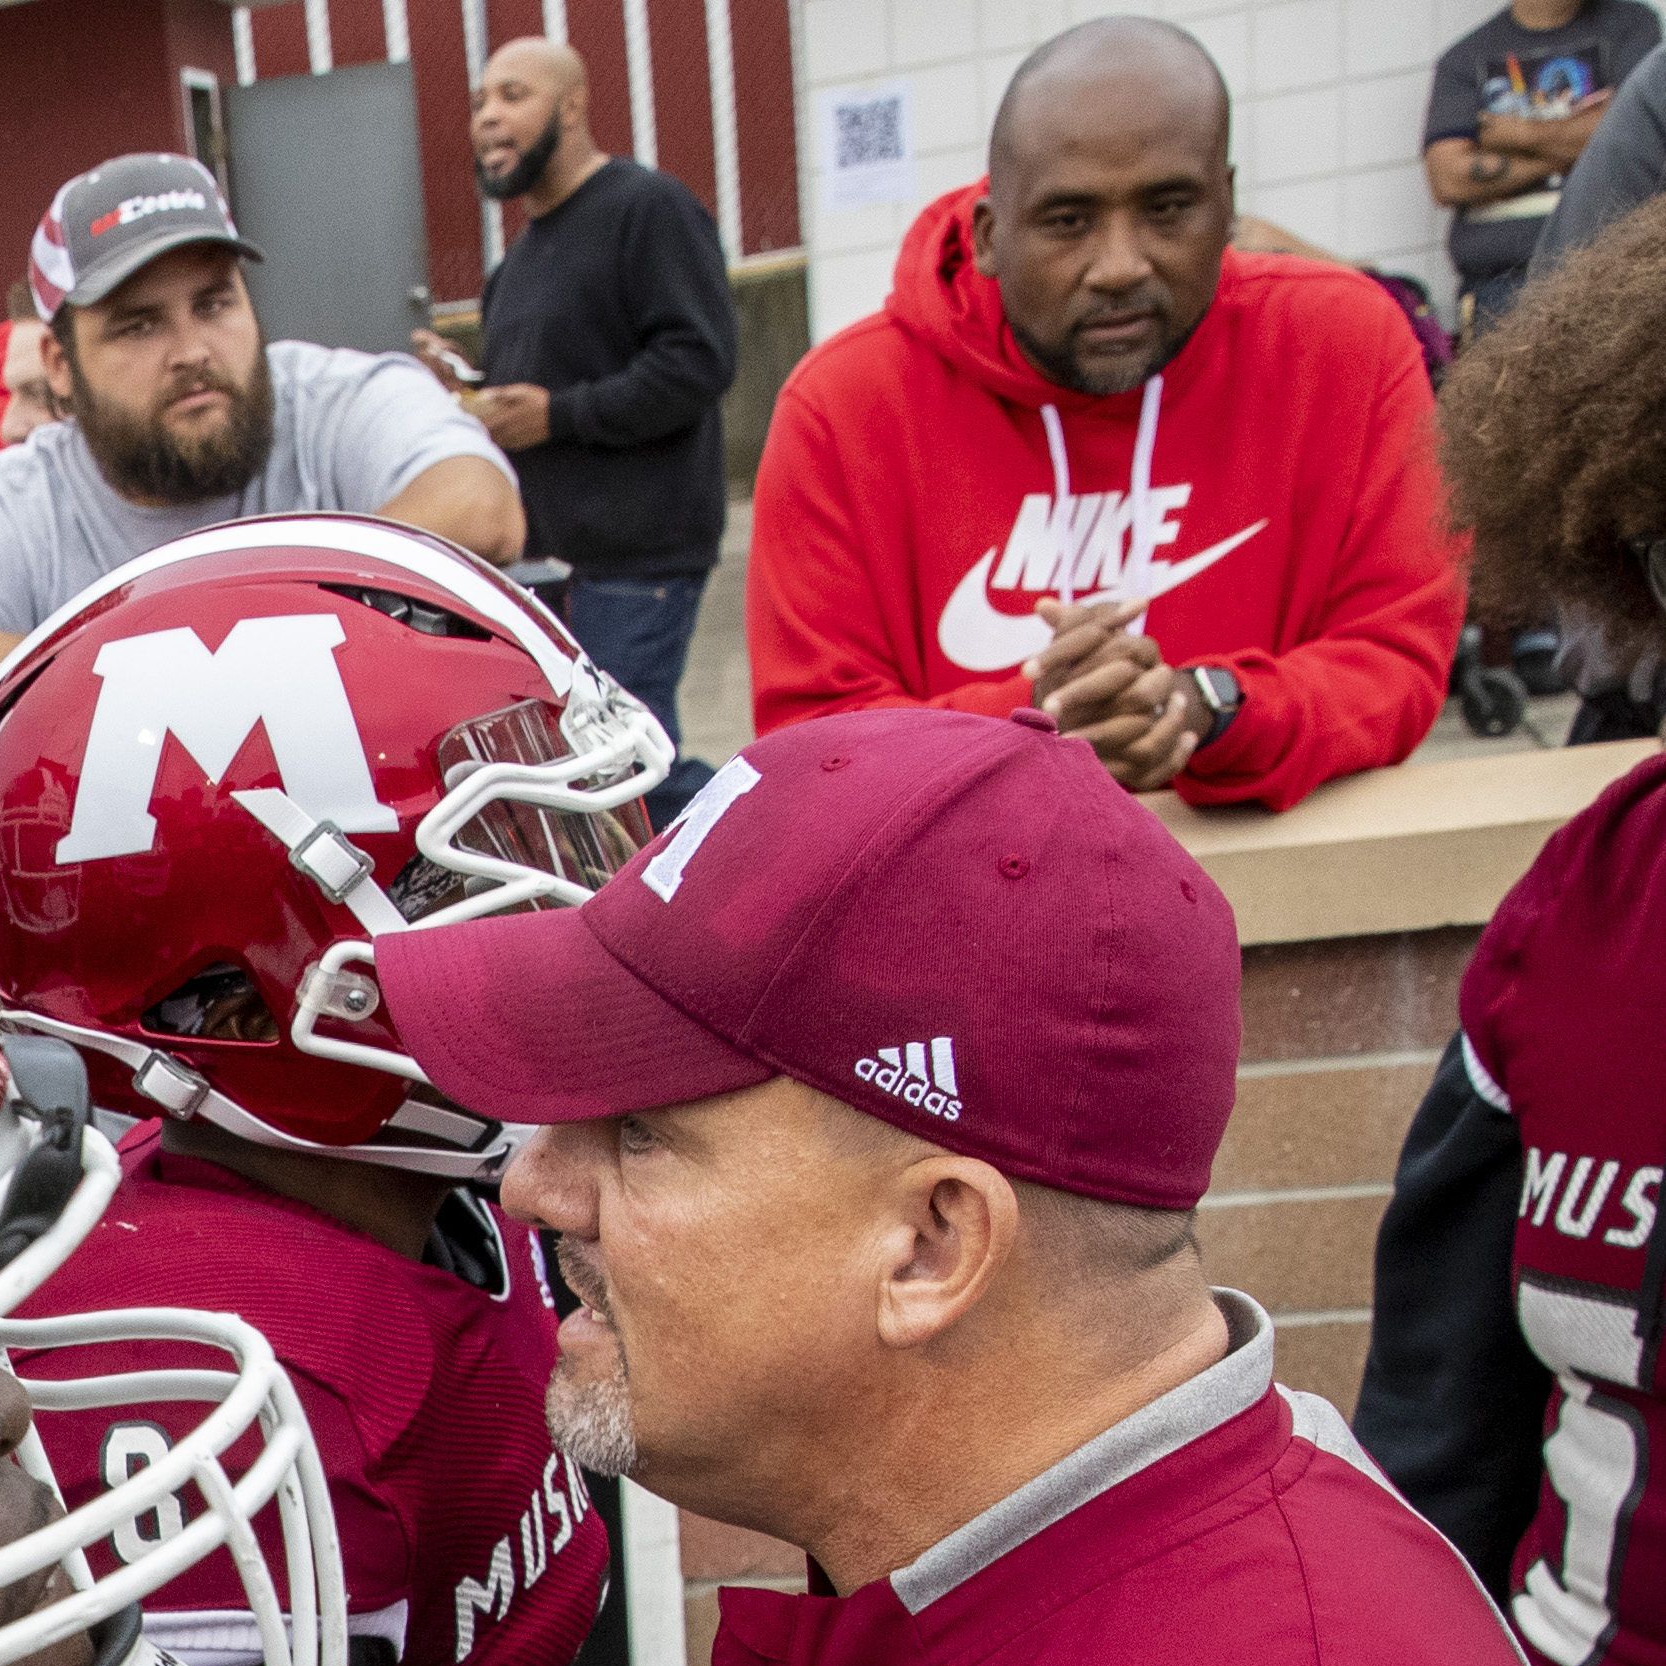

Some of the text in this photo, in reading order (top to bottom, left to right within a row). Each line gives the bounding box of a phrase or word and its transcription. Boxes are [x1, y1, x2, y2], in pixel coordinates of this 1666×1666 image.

[991, 482, 1193, 592] NIKE
[55, 613, 400, 866] M
[854, 1055, 963, 1123] adidas
